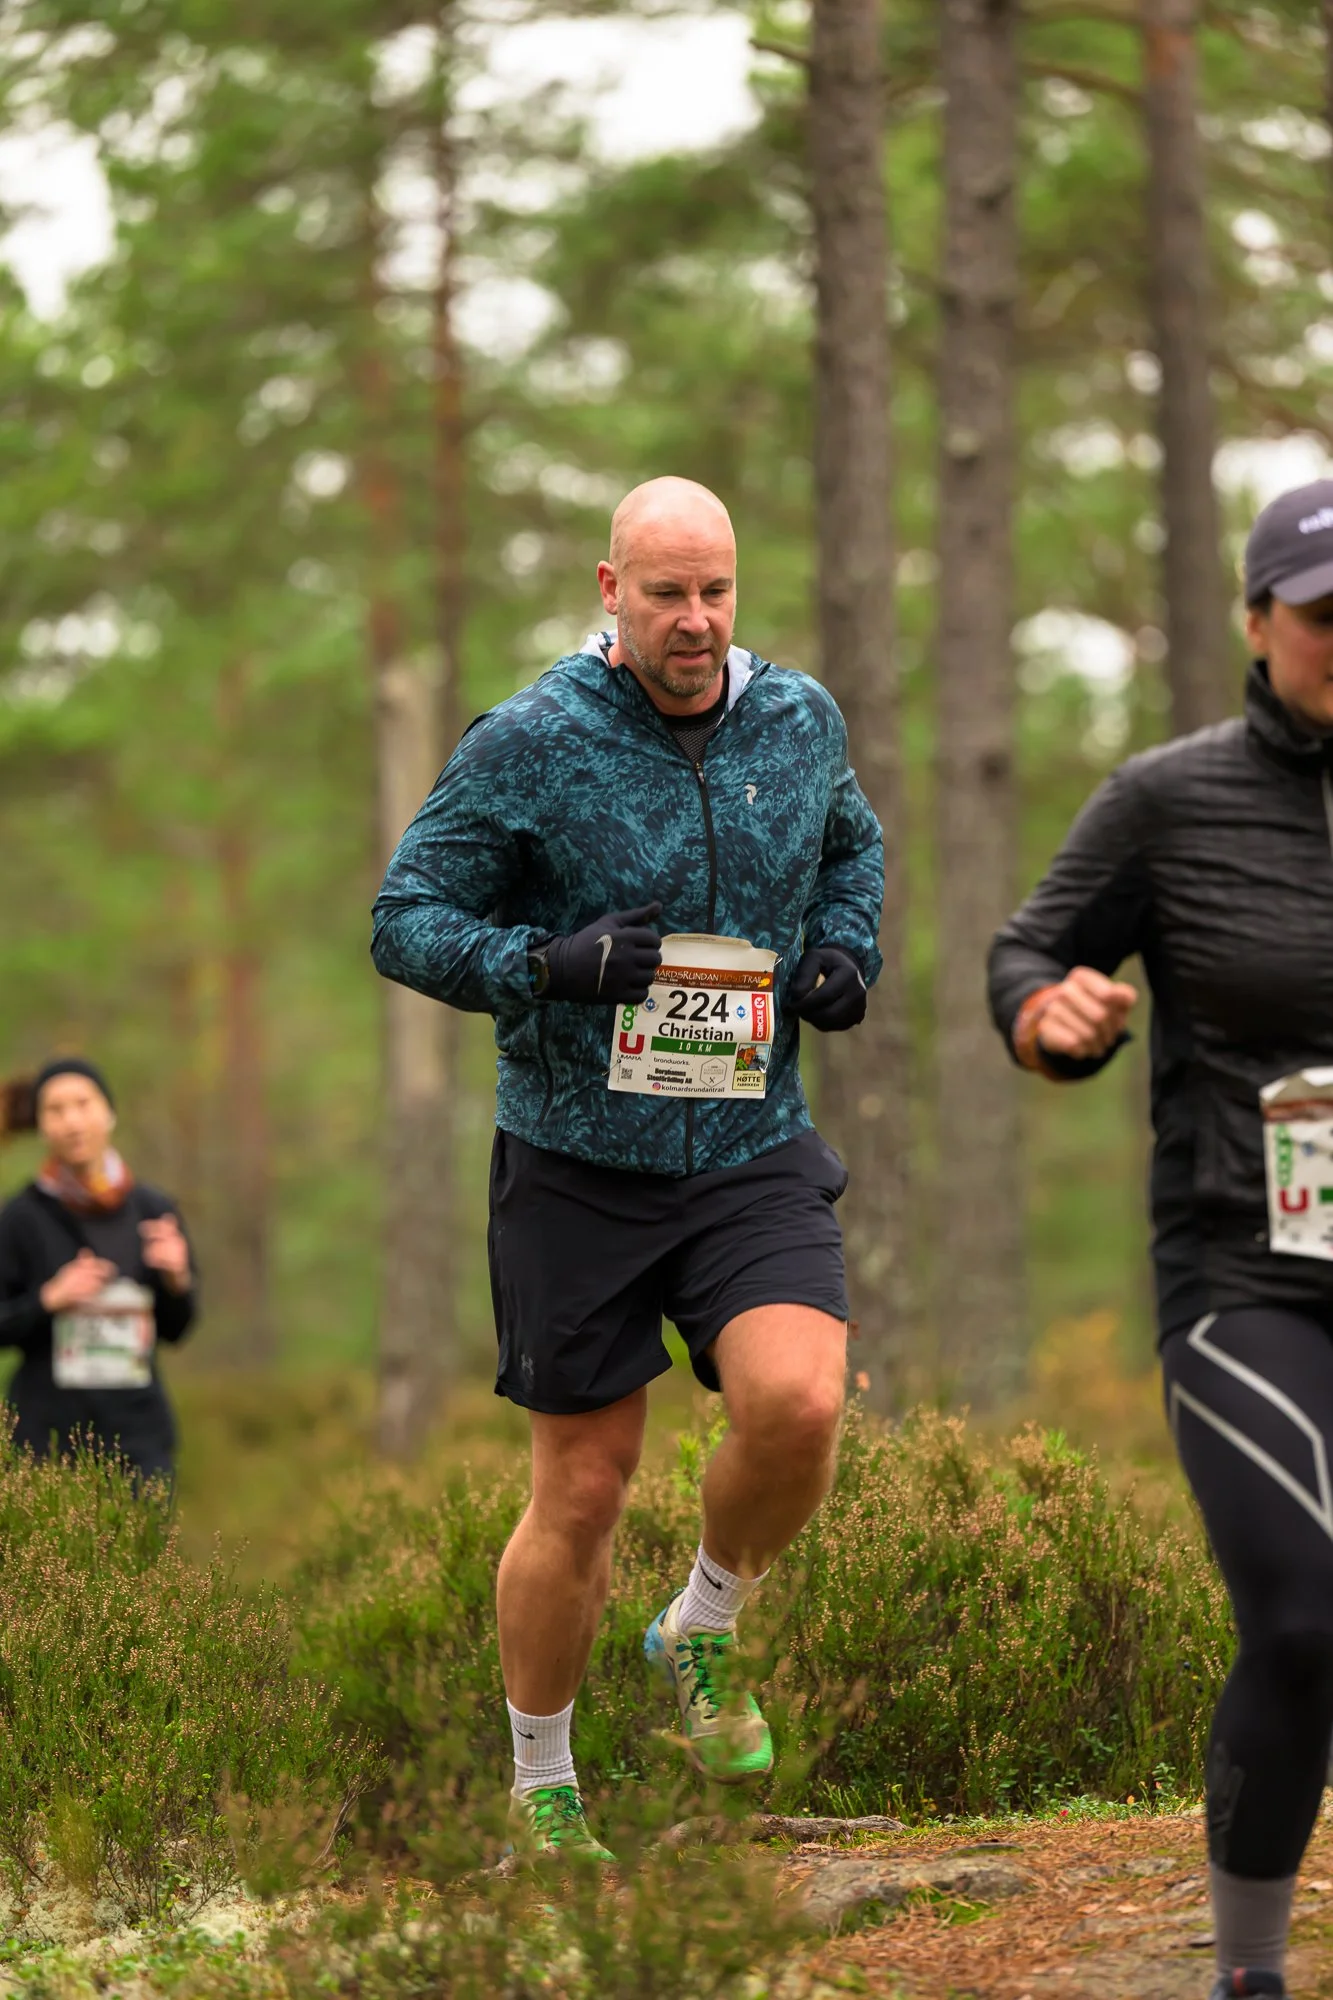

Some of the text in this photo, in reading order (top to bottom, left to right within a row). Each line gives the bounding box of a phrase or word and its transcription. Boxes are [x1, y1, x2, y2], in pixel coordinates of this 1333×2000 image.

[665, 990, 730, 1023] 224
[658, 1022, 734, 1041] Christian
[756, 1009, 764, 1038] CIRCLE
[678, 1042, 713, 1052] 10 KM
[661, 1084, 725, 1093] kolmardsrundantrail
